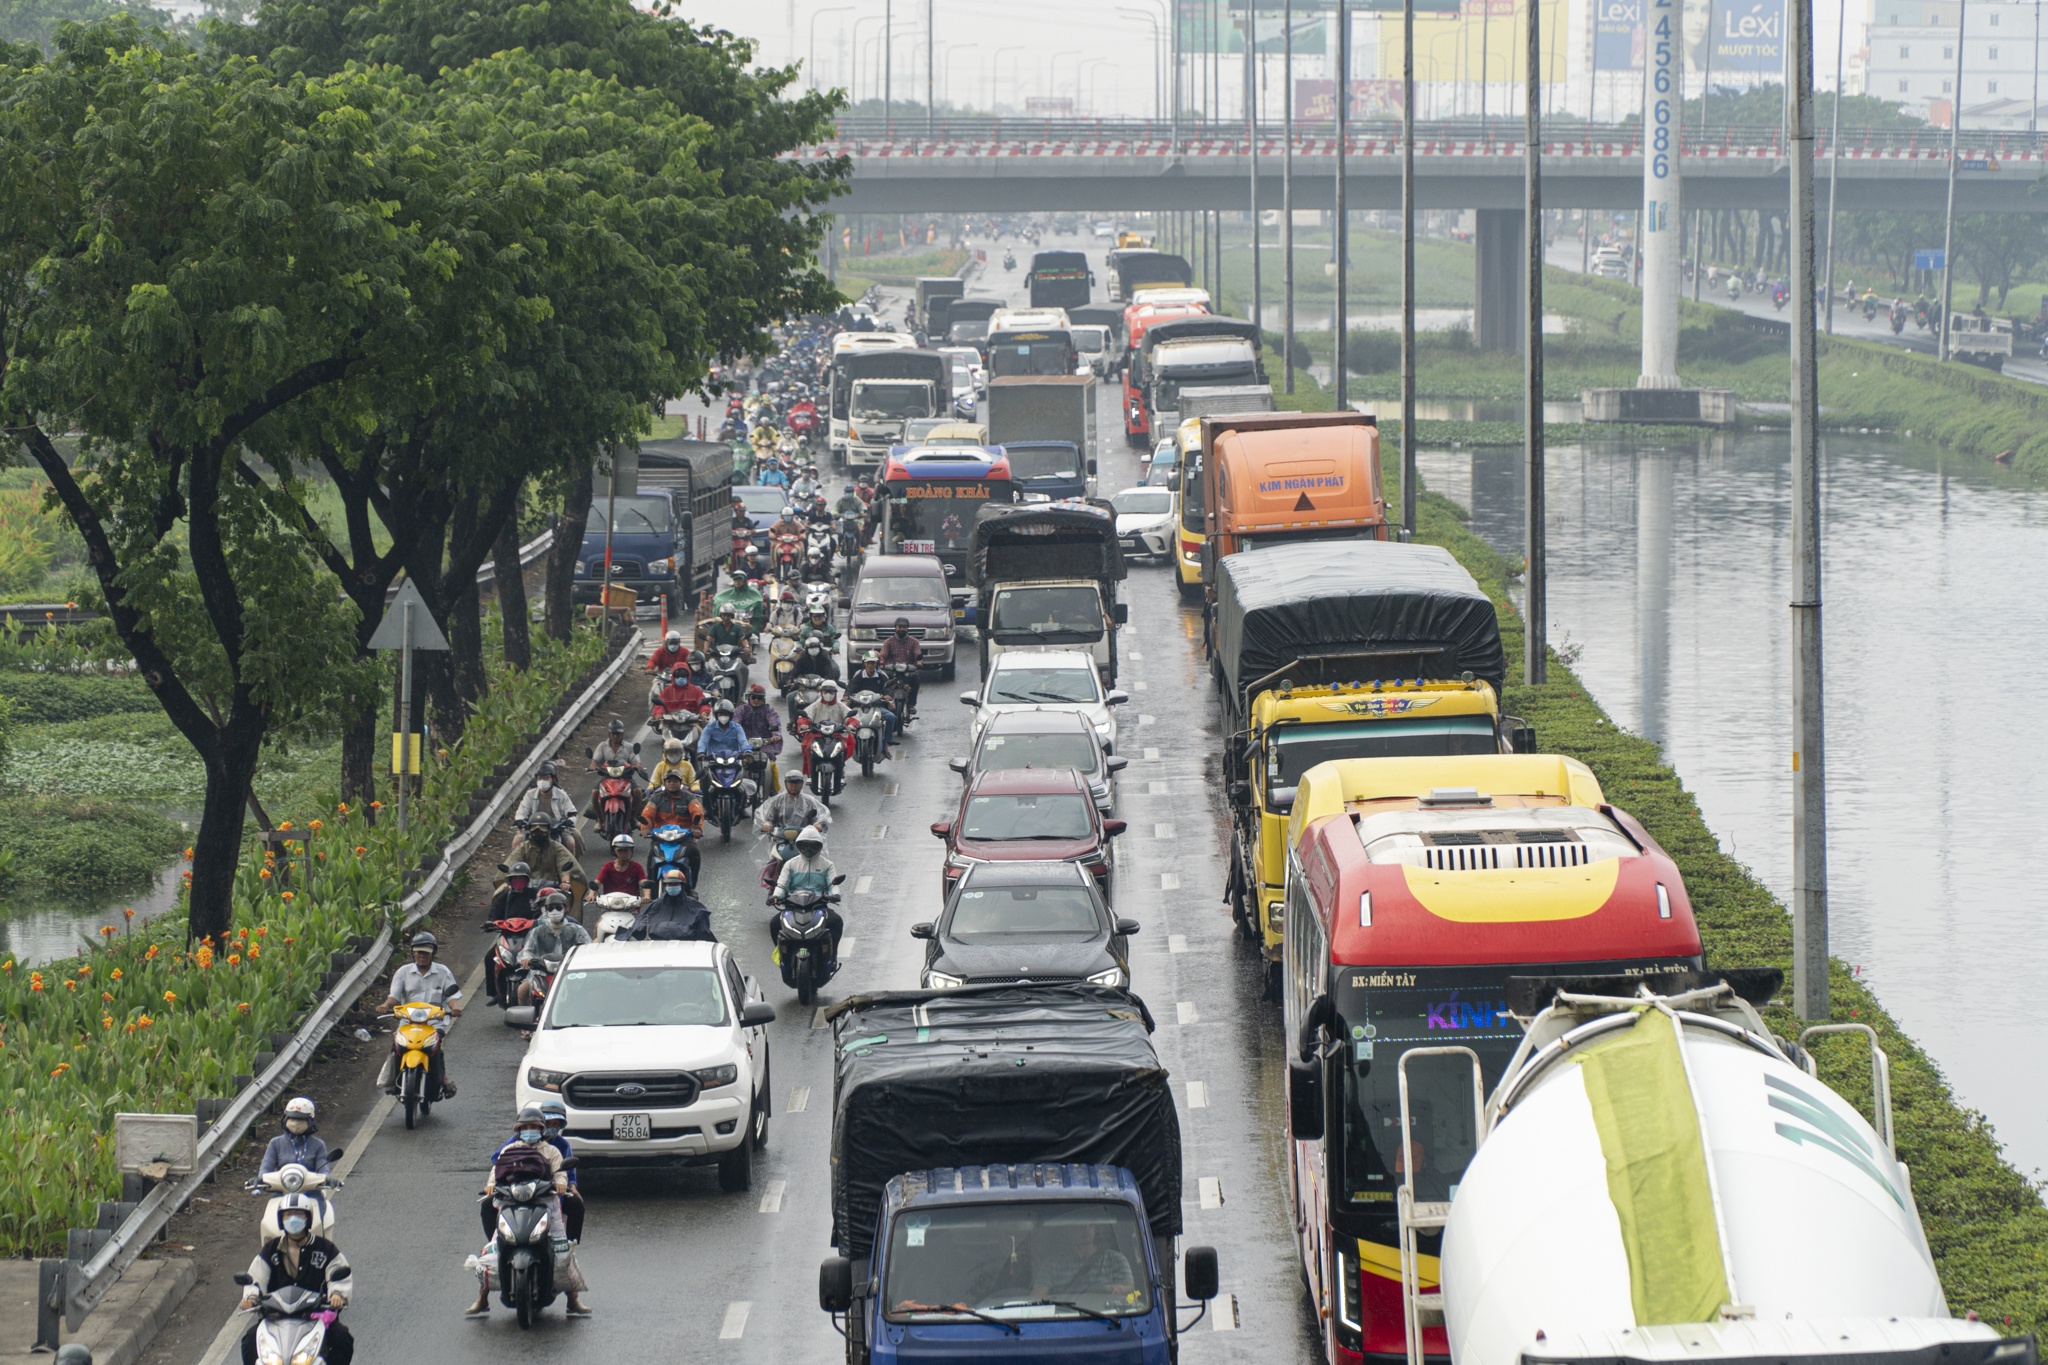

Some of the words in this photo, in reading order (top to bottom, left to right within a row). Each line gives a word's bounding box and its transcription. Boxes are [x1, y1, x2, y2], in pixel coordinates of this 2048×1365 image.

[1725, 4, 1779, 38] Léxi
[955, 483, 990, 499] KHẢI
[1259, 480, 1282, 492] KIM
[1284, 476, 1315, 490] NGÂN
[904, 540, 919, 553] BẾN
[921, 543, 934, 553] TRE
[1352, 975, 1369, 987] BX:
[1369, 971, 1394, 987] MIỀN
[1395, 972, 1417, 987] TÂY
[1427, 991, 1507, 1029] KÍNH
[622, 1115, 641, 1127] 37C
[615, 1127, 649, 1139] 356.84
